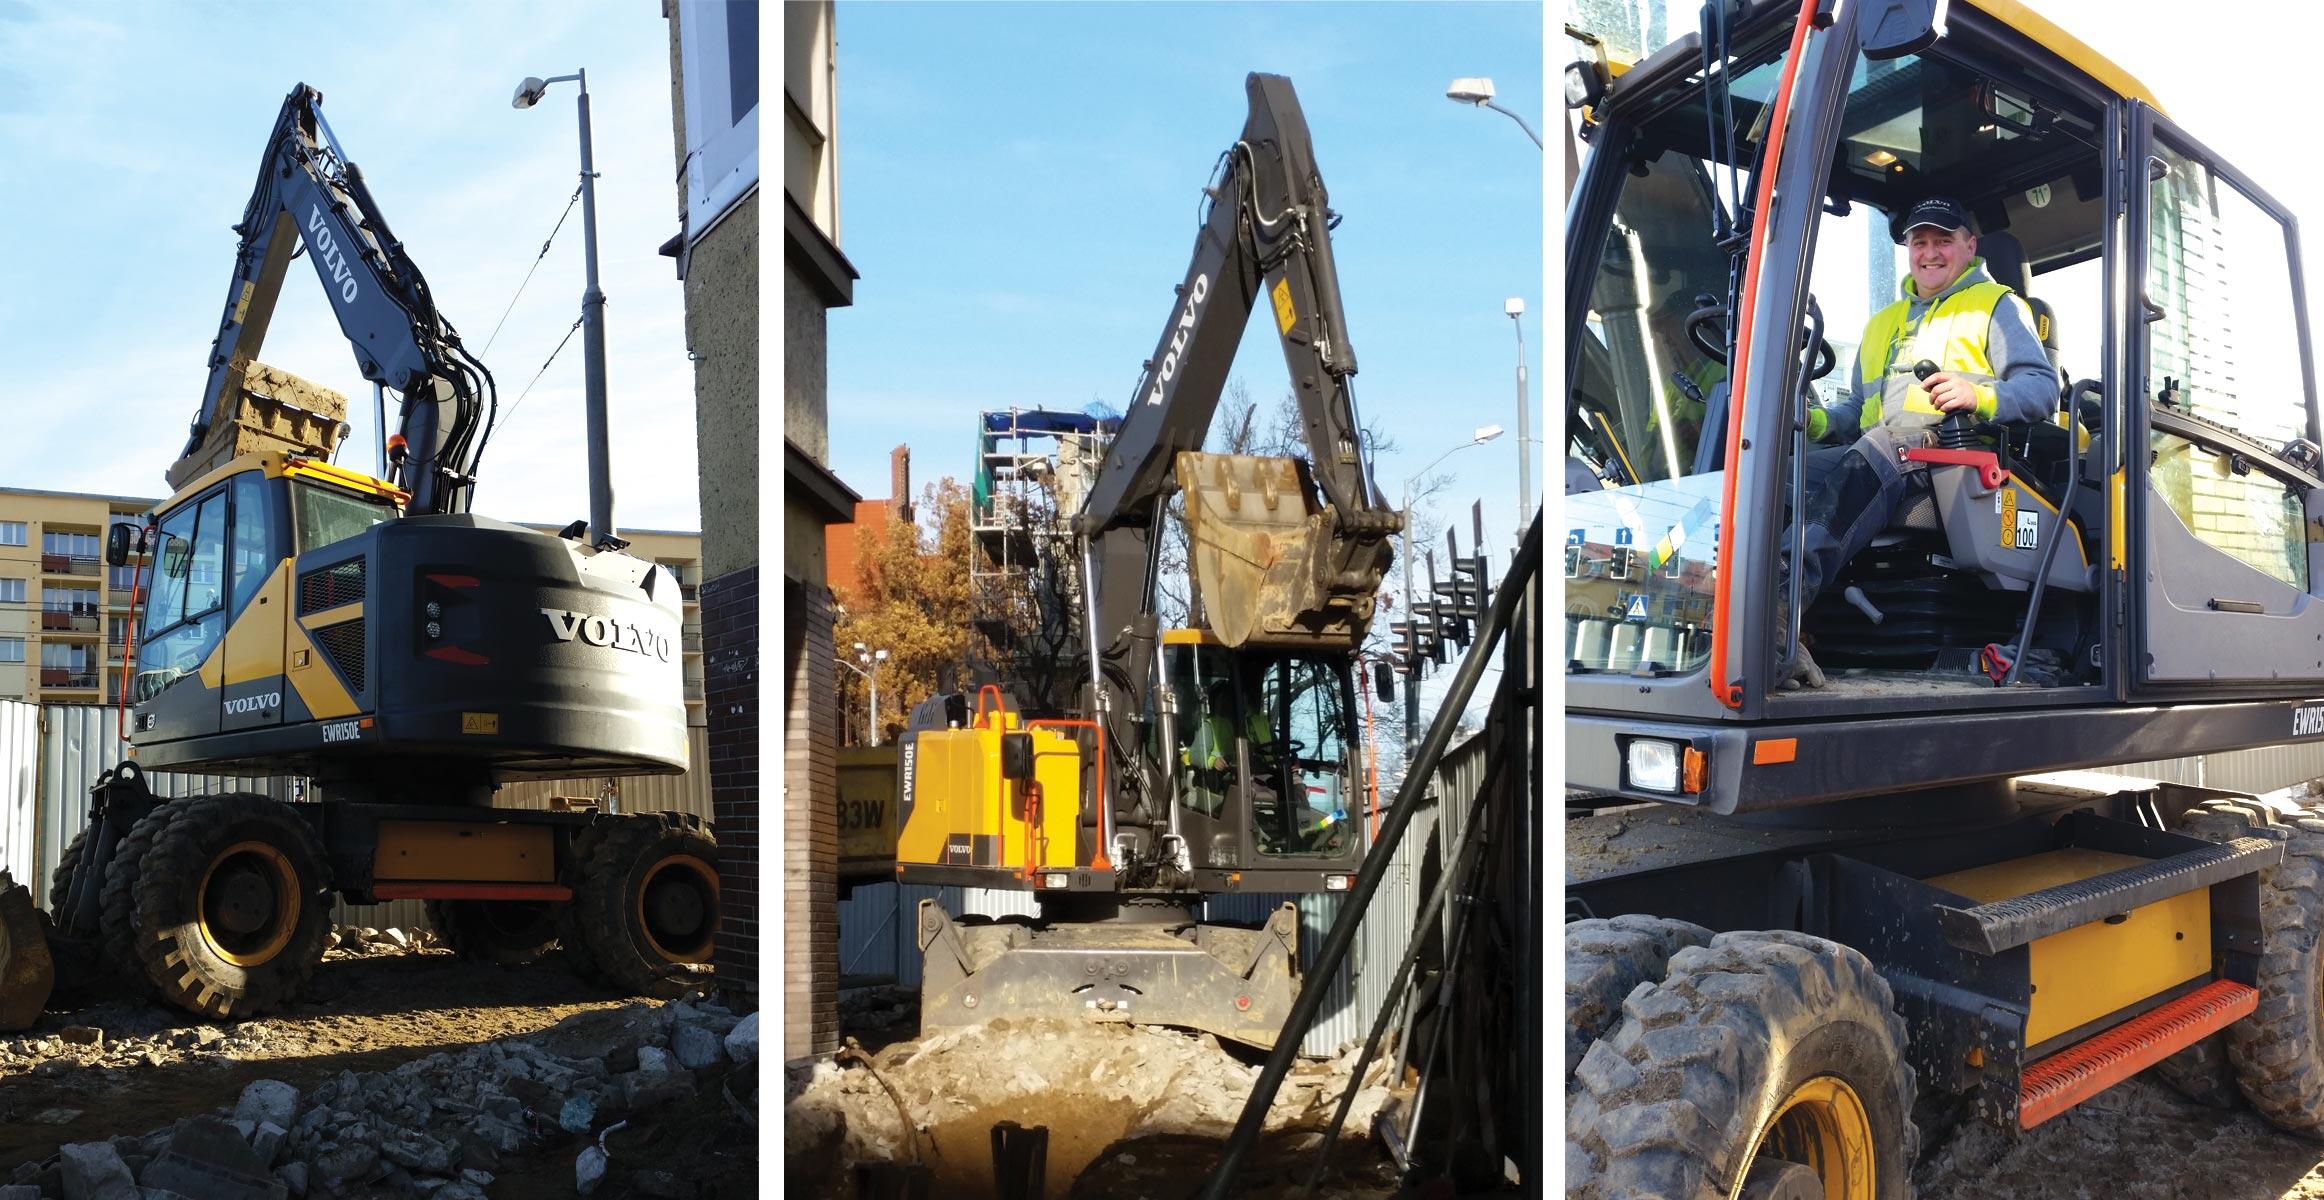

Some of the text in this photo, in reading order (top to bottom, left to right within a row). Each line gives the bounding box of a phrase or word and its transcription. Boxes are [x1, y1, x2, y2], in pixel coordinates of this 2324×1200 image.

[308, 203, 358, 304] VOLVO
[1147, 273, 1208, 407] VOLVO
[2016, 527, 2034, 547] 100
[540, 607, 670, 665] VOLVO
[224, 692, 281, 715] VOLVO
[322, 720, 361, 743] EWR150E
[2292, 706, 2324, 736] EWR15
[903, 742, 915, 801] EWR150E
[948, 844, 971, 854] VOLVO
